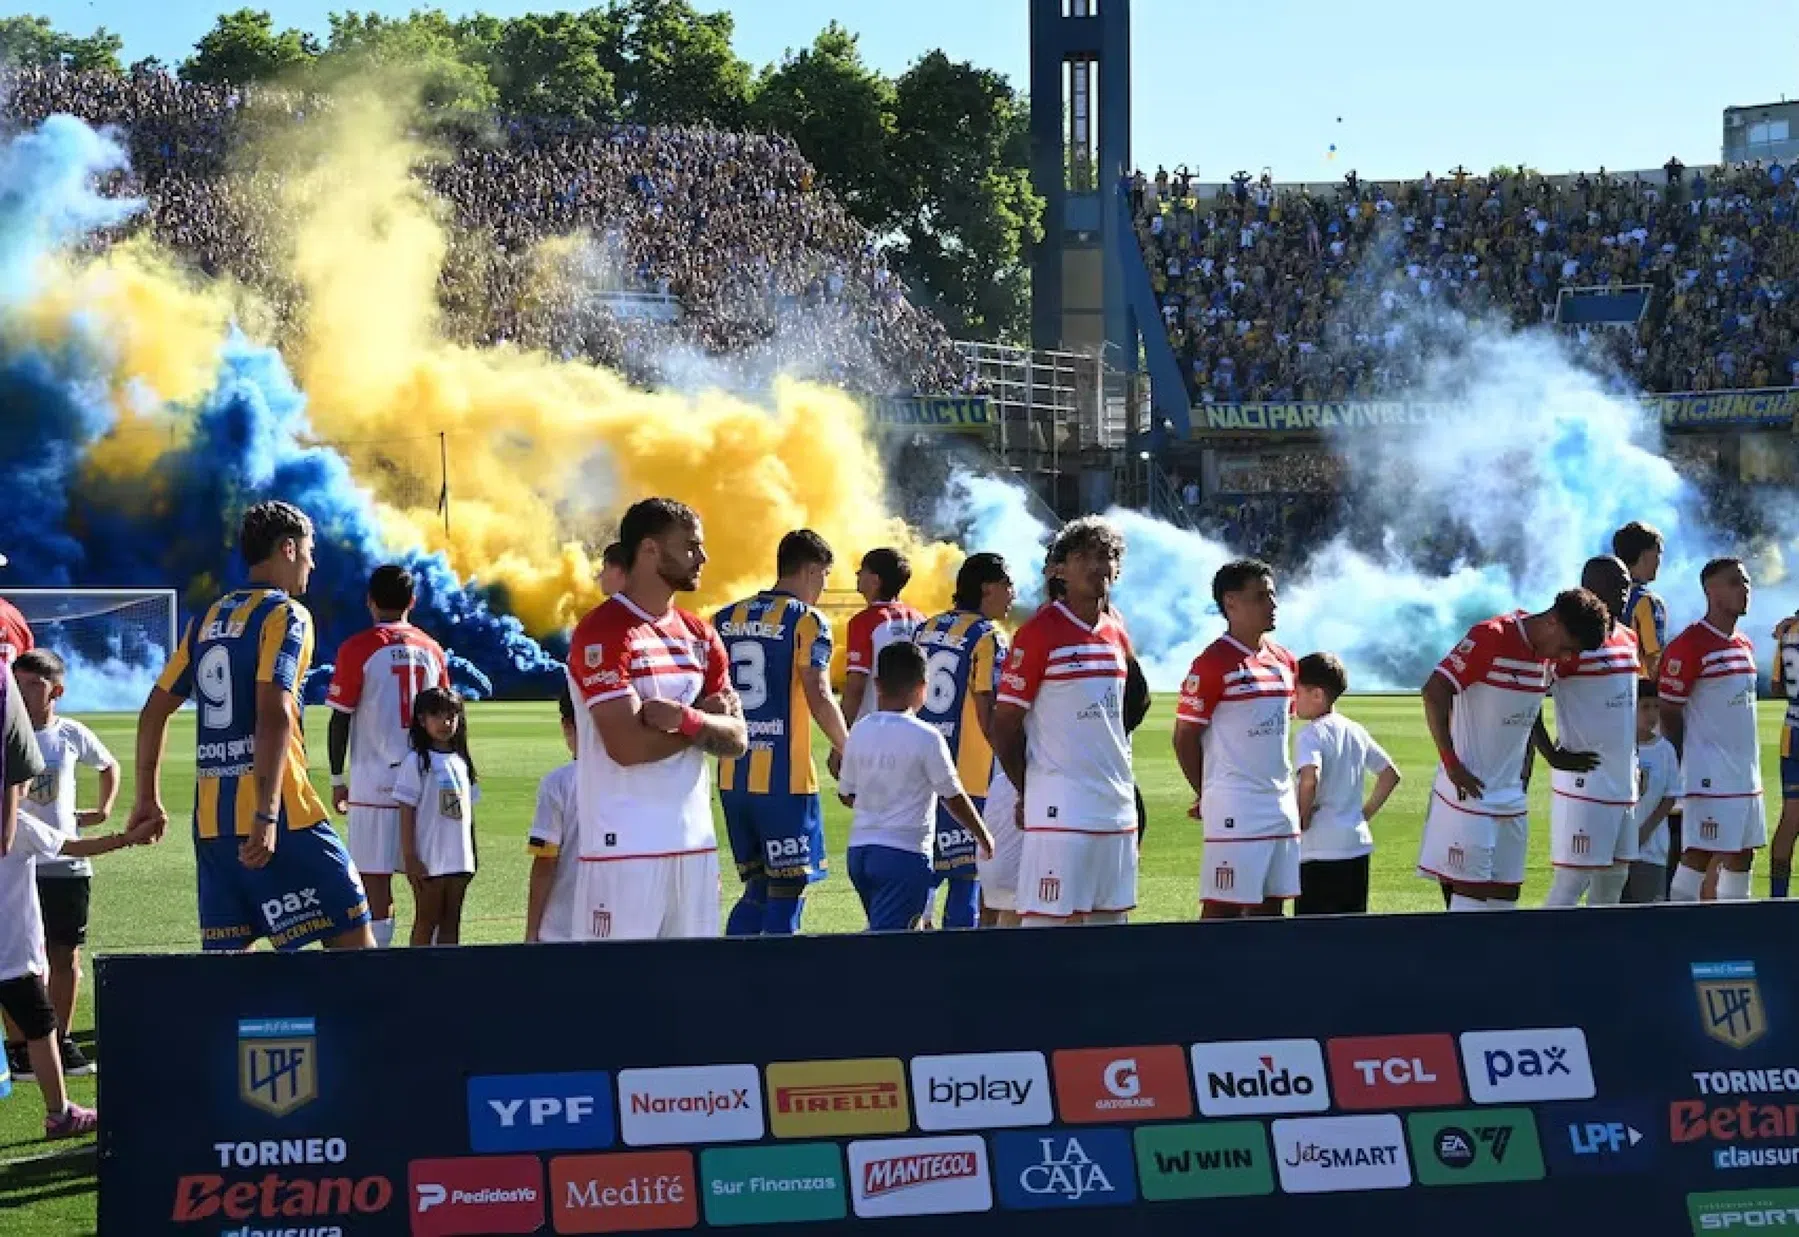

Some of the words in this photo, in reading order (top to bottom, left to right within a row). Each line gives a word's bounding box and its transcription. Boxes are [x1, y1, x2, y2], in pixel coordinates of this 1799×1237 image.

[198, 645, 233, 729] 9
[730, 641, 768, 709] 3
[924, 651, 958, 715] 6
[766, 836, 810, 866] pax
[262, 888, 321, 928] pax
[1103, 1059, 1141, 1098] G
[1353, 1058, 1437, 1086] TCL
[1484, 1046, 1572, 1087] pax
[1693, 1068, 1799, 1095] TORNEO
[776, 1082, 898, 1113] PIRELLI
[1207, 1067, 1314, 1099] Naldo
[489, 1097, 594, 1127] YPF
[631, 1088, 749, 1117] NaranjaX
[214, 1137, 347, 1168] TORNEO
[1037, 1137, 1092, 1165] LA
[1441, 1135, 1468, 1151] EA
[1568, 1123, 1626, 1153] LPF
[1196, 1148, 1252, 1169] WIN
[1285, 1141, 1398, 1168] JetSMART
[711, 1179, 744, 1195] Sur
[751, 1176, 836, 1193] Finanzas
[865, 1152, 974, 1190] MANTECOL
[1019, 1164, 1115, 1199] CAJA
[172, 1174, 392, 1222] Betano
[451, 1188, 537, 1205] PedidosYa
[565, 1176, 685, 1209] Medifé
